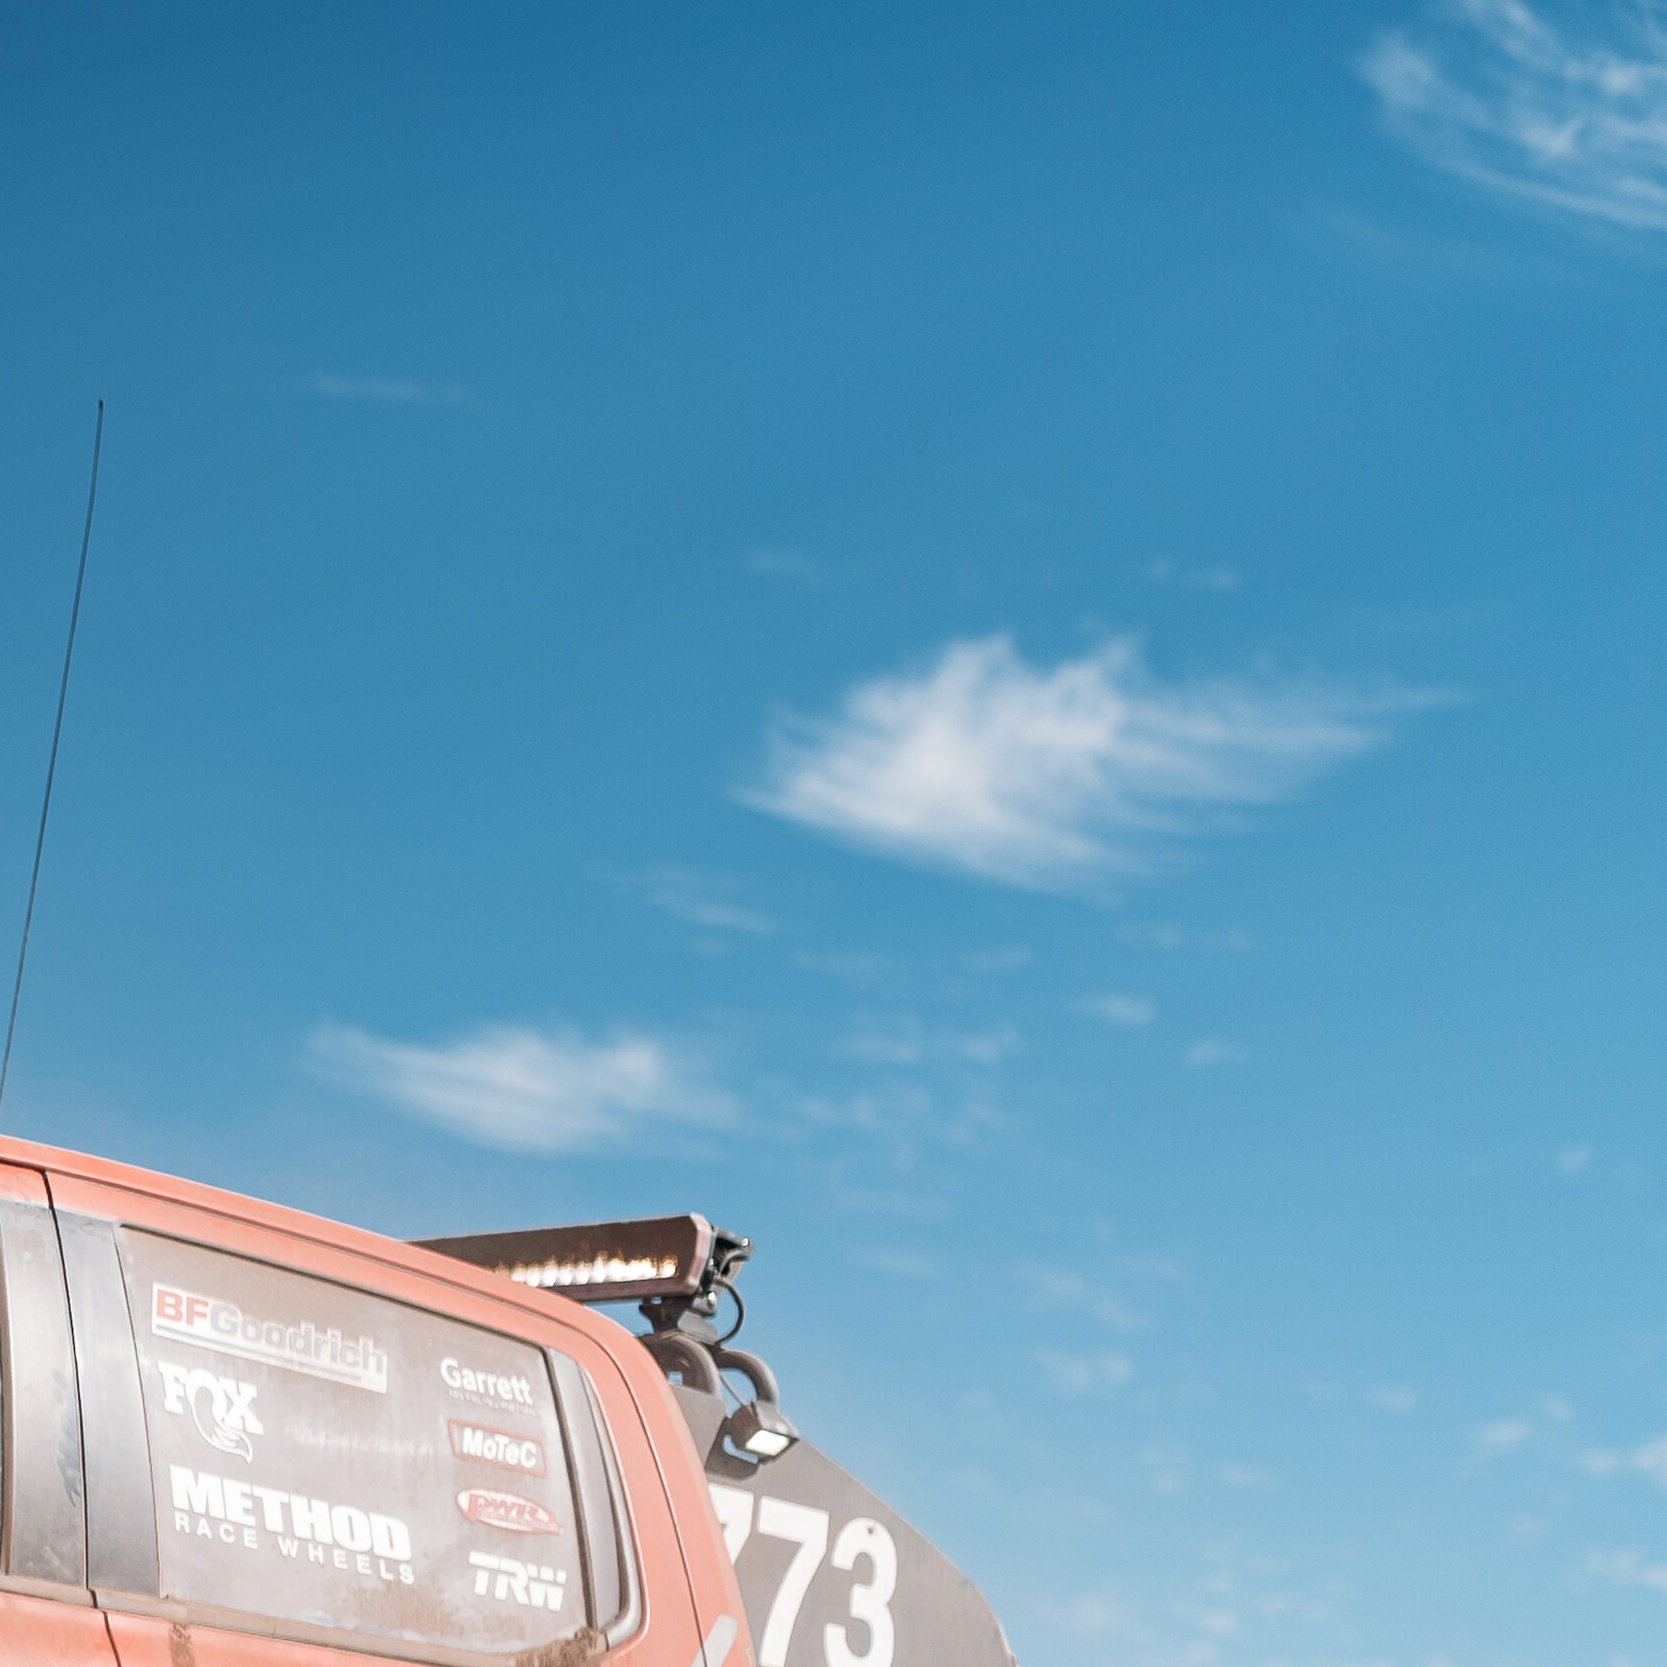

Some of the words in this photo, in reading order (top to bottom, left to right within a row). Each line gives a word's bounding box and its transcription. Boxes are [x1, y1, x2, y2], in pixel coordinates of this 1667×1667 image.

[156, 1289, 386, 1374] BFGoodrich
[157, 1360, 264, 1463] FOX
[440, 1357, 534, 1405] Garrett
[462, 1426, 537, 1469] MoTeC
[169, 1464, 412, 1561] METHOD
[174, 1511, 259, 1550] RACE
[277, 1536, 416, 1586] WHEELS
[469, 1551, 567, 1612] TRW
